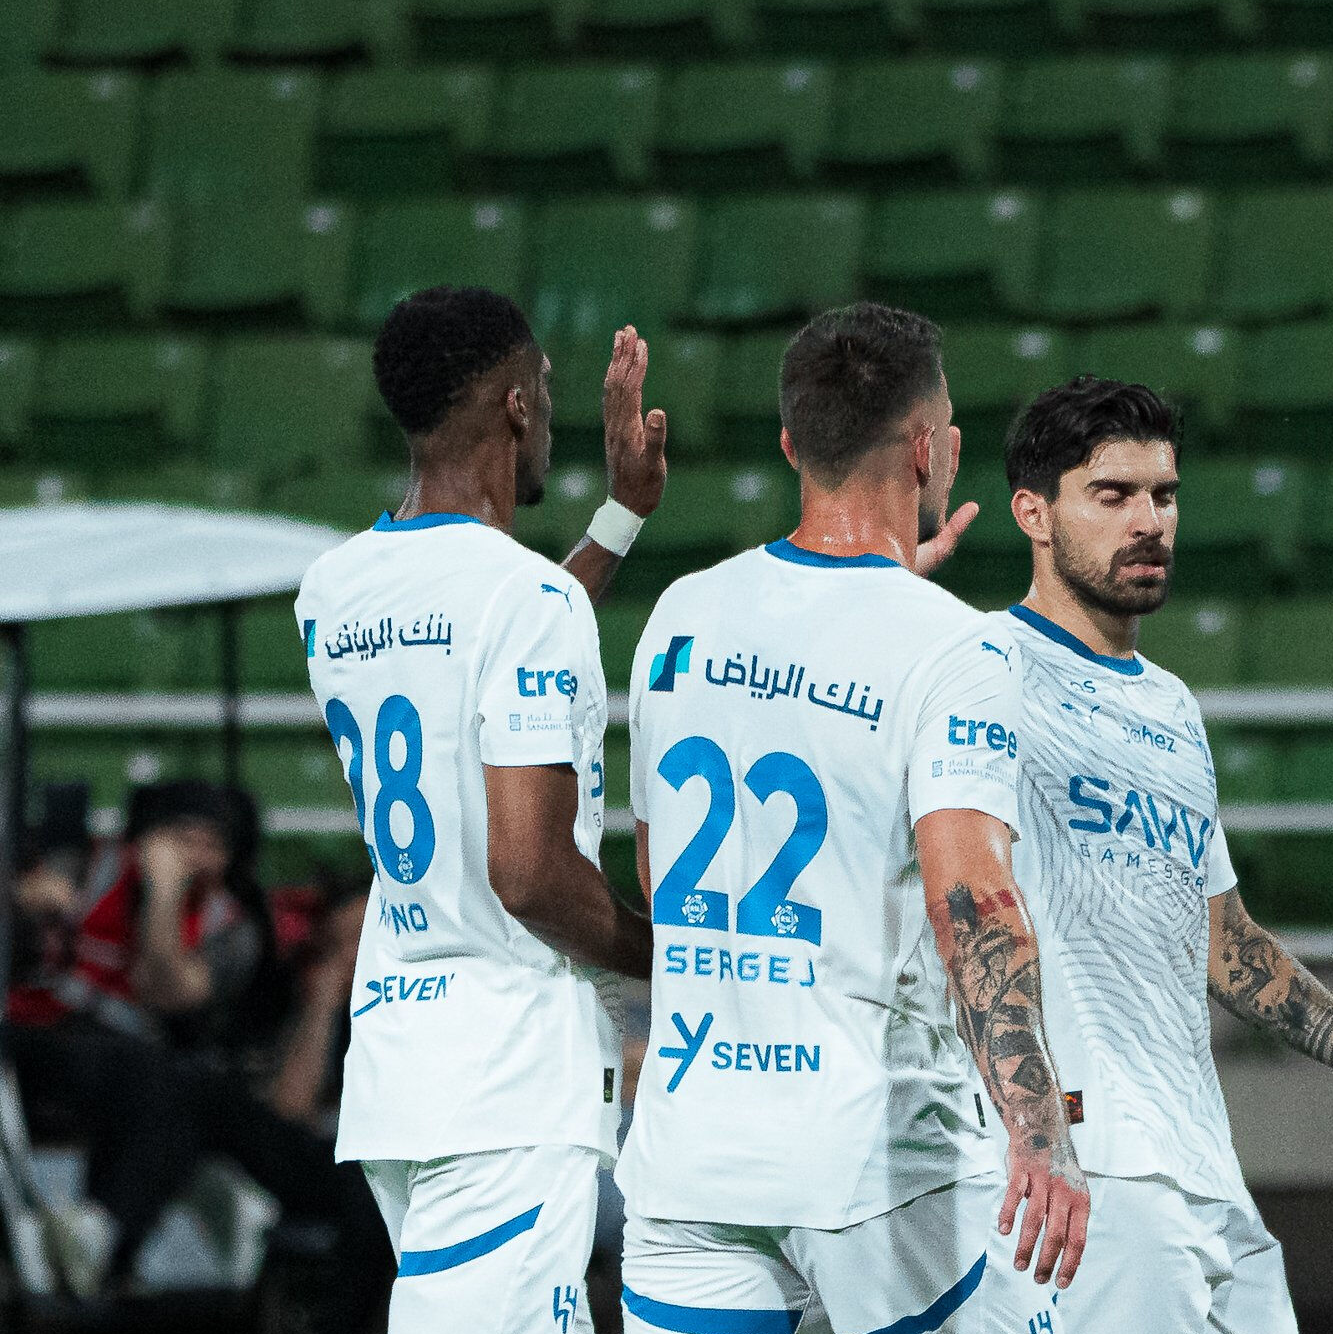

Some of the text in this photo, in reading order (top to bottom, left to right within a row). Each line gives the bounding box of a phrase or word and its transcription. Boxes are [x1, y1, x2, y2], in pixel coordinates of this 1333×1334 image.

[324, 613, 451, 661] بنك الرياض
[705, 652, 884, 732] بنك الرياض
[947, 714, 1018, 760] tree
[653, 735, 828, 947] 22
[664, 943, 816, 988] SERGEJ
[711, 1040, 821, 1073] SEVEN
